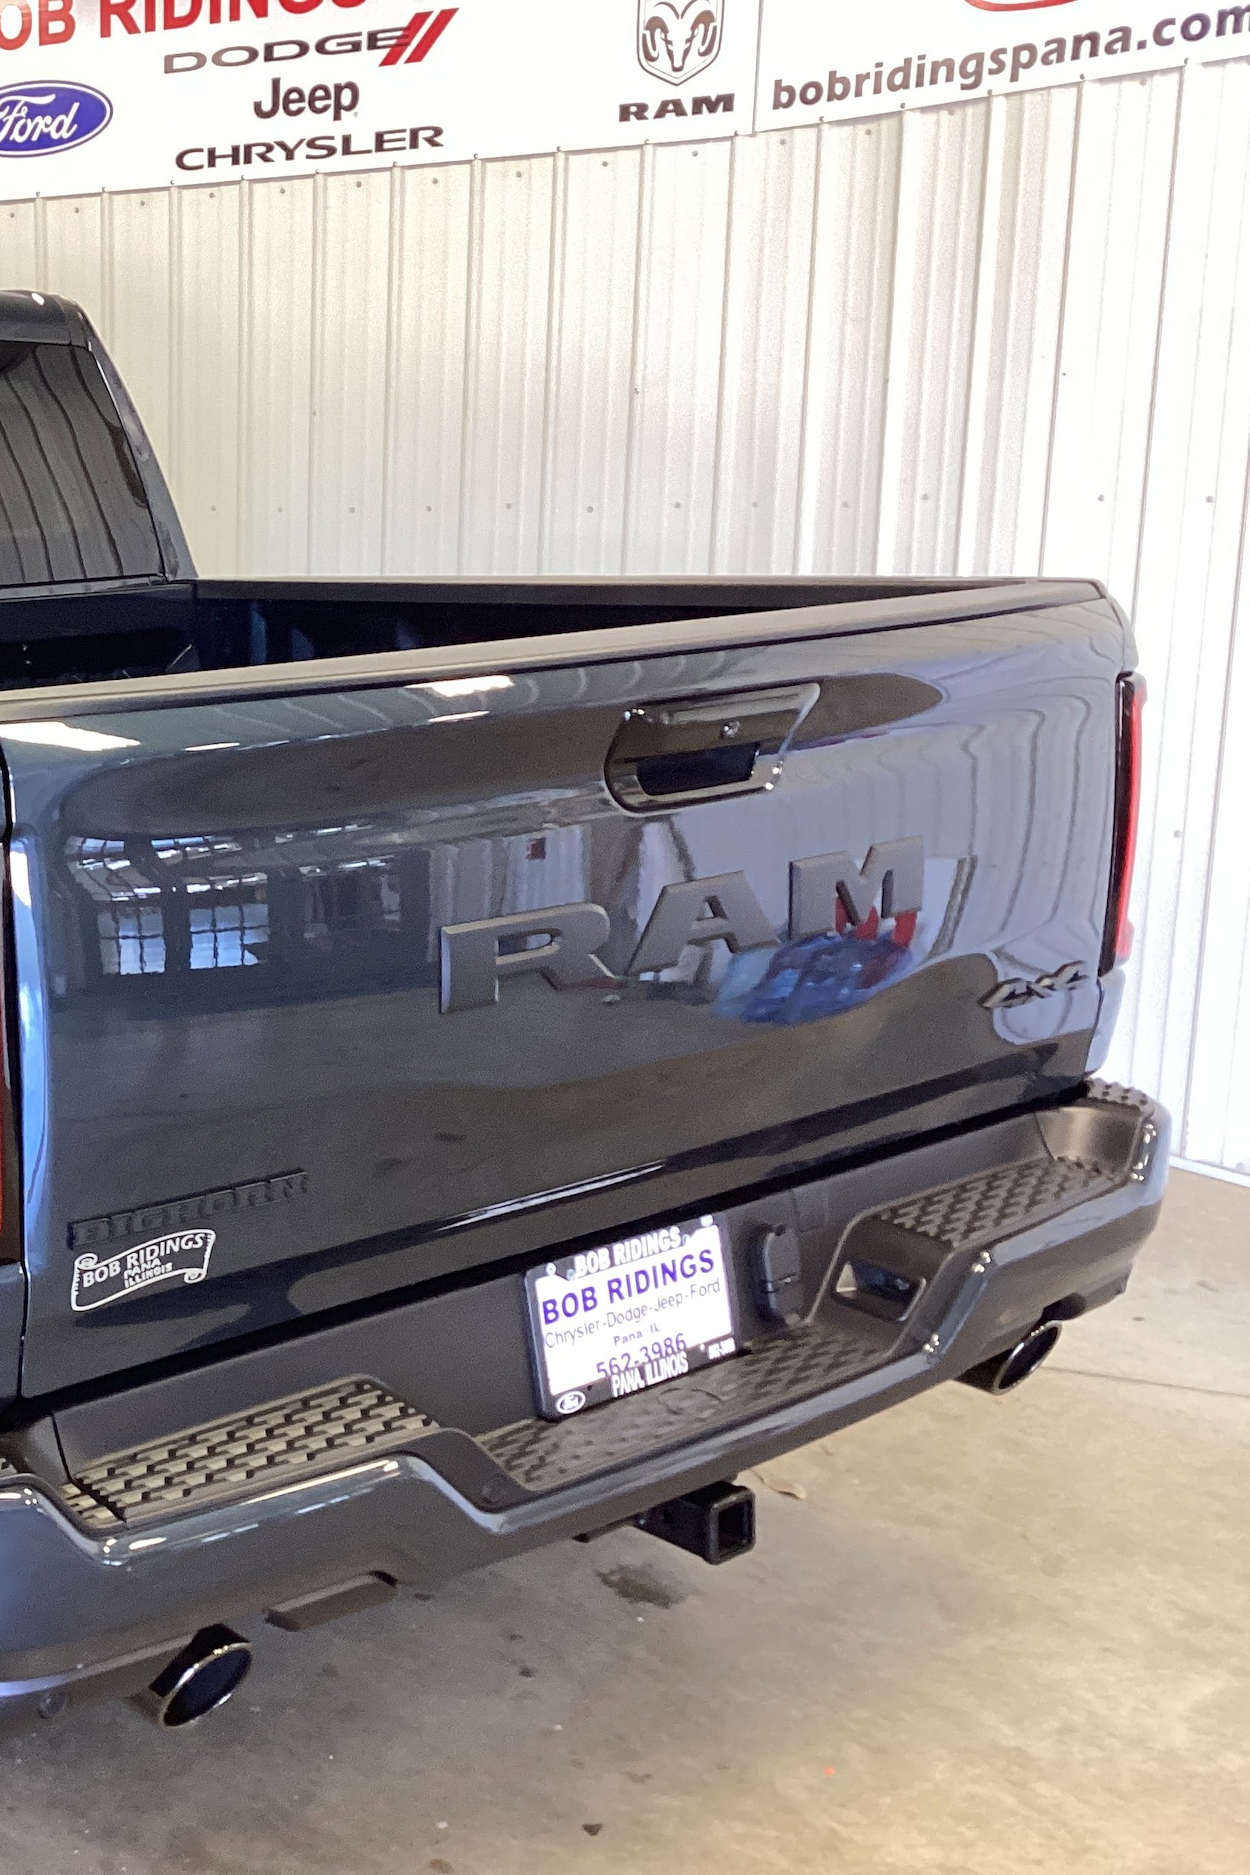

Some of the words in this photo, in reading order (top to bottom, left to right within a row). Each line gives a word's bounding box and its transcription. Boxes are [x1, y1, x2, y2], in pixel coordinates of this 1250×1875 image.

[163, 26, 412, 74] DODGE
[772, 4, 1250, 110] bobridingspana.com
[253, 77, 359, 121] Jeep
[618, 93, 736, 122] RAM
[175, 126, 445, 171] CHRYSLER
[440, 835, 925, 1014] RAM
[67, 1206, 165, 1250] BIG
[167, 1168, 309, 1226] HORN
[82, 1260, 121, 1288] BOB
[126, 1233, 206, 1269] RIDINGS
[124, 1258, 161, 1280] PANA
[574, 1247, 611, 1278] BOB
[613, 1226, 682, 1266] RIDINGS
[124, 1263, 173, 1288] ILLINOIS
[542, 1286, 598, 1325] BOB
[607, 1249, 715, 1304] RIDINGS
[613, 1331, 643, 1346] Pana
[650, 1323, 661, 1334] IL
[645, 1351, 689, 1387] ILLINOIS
